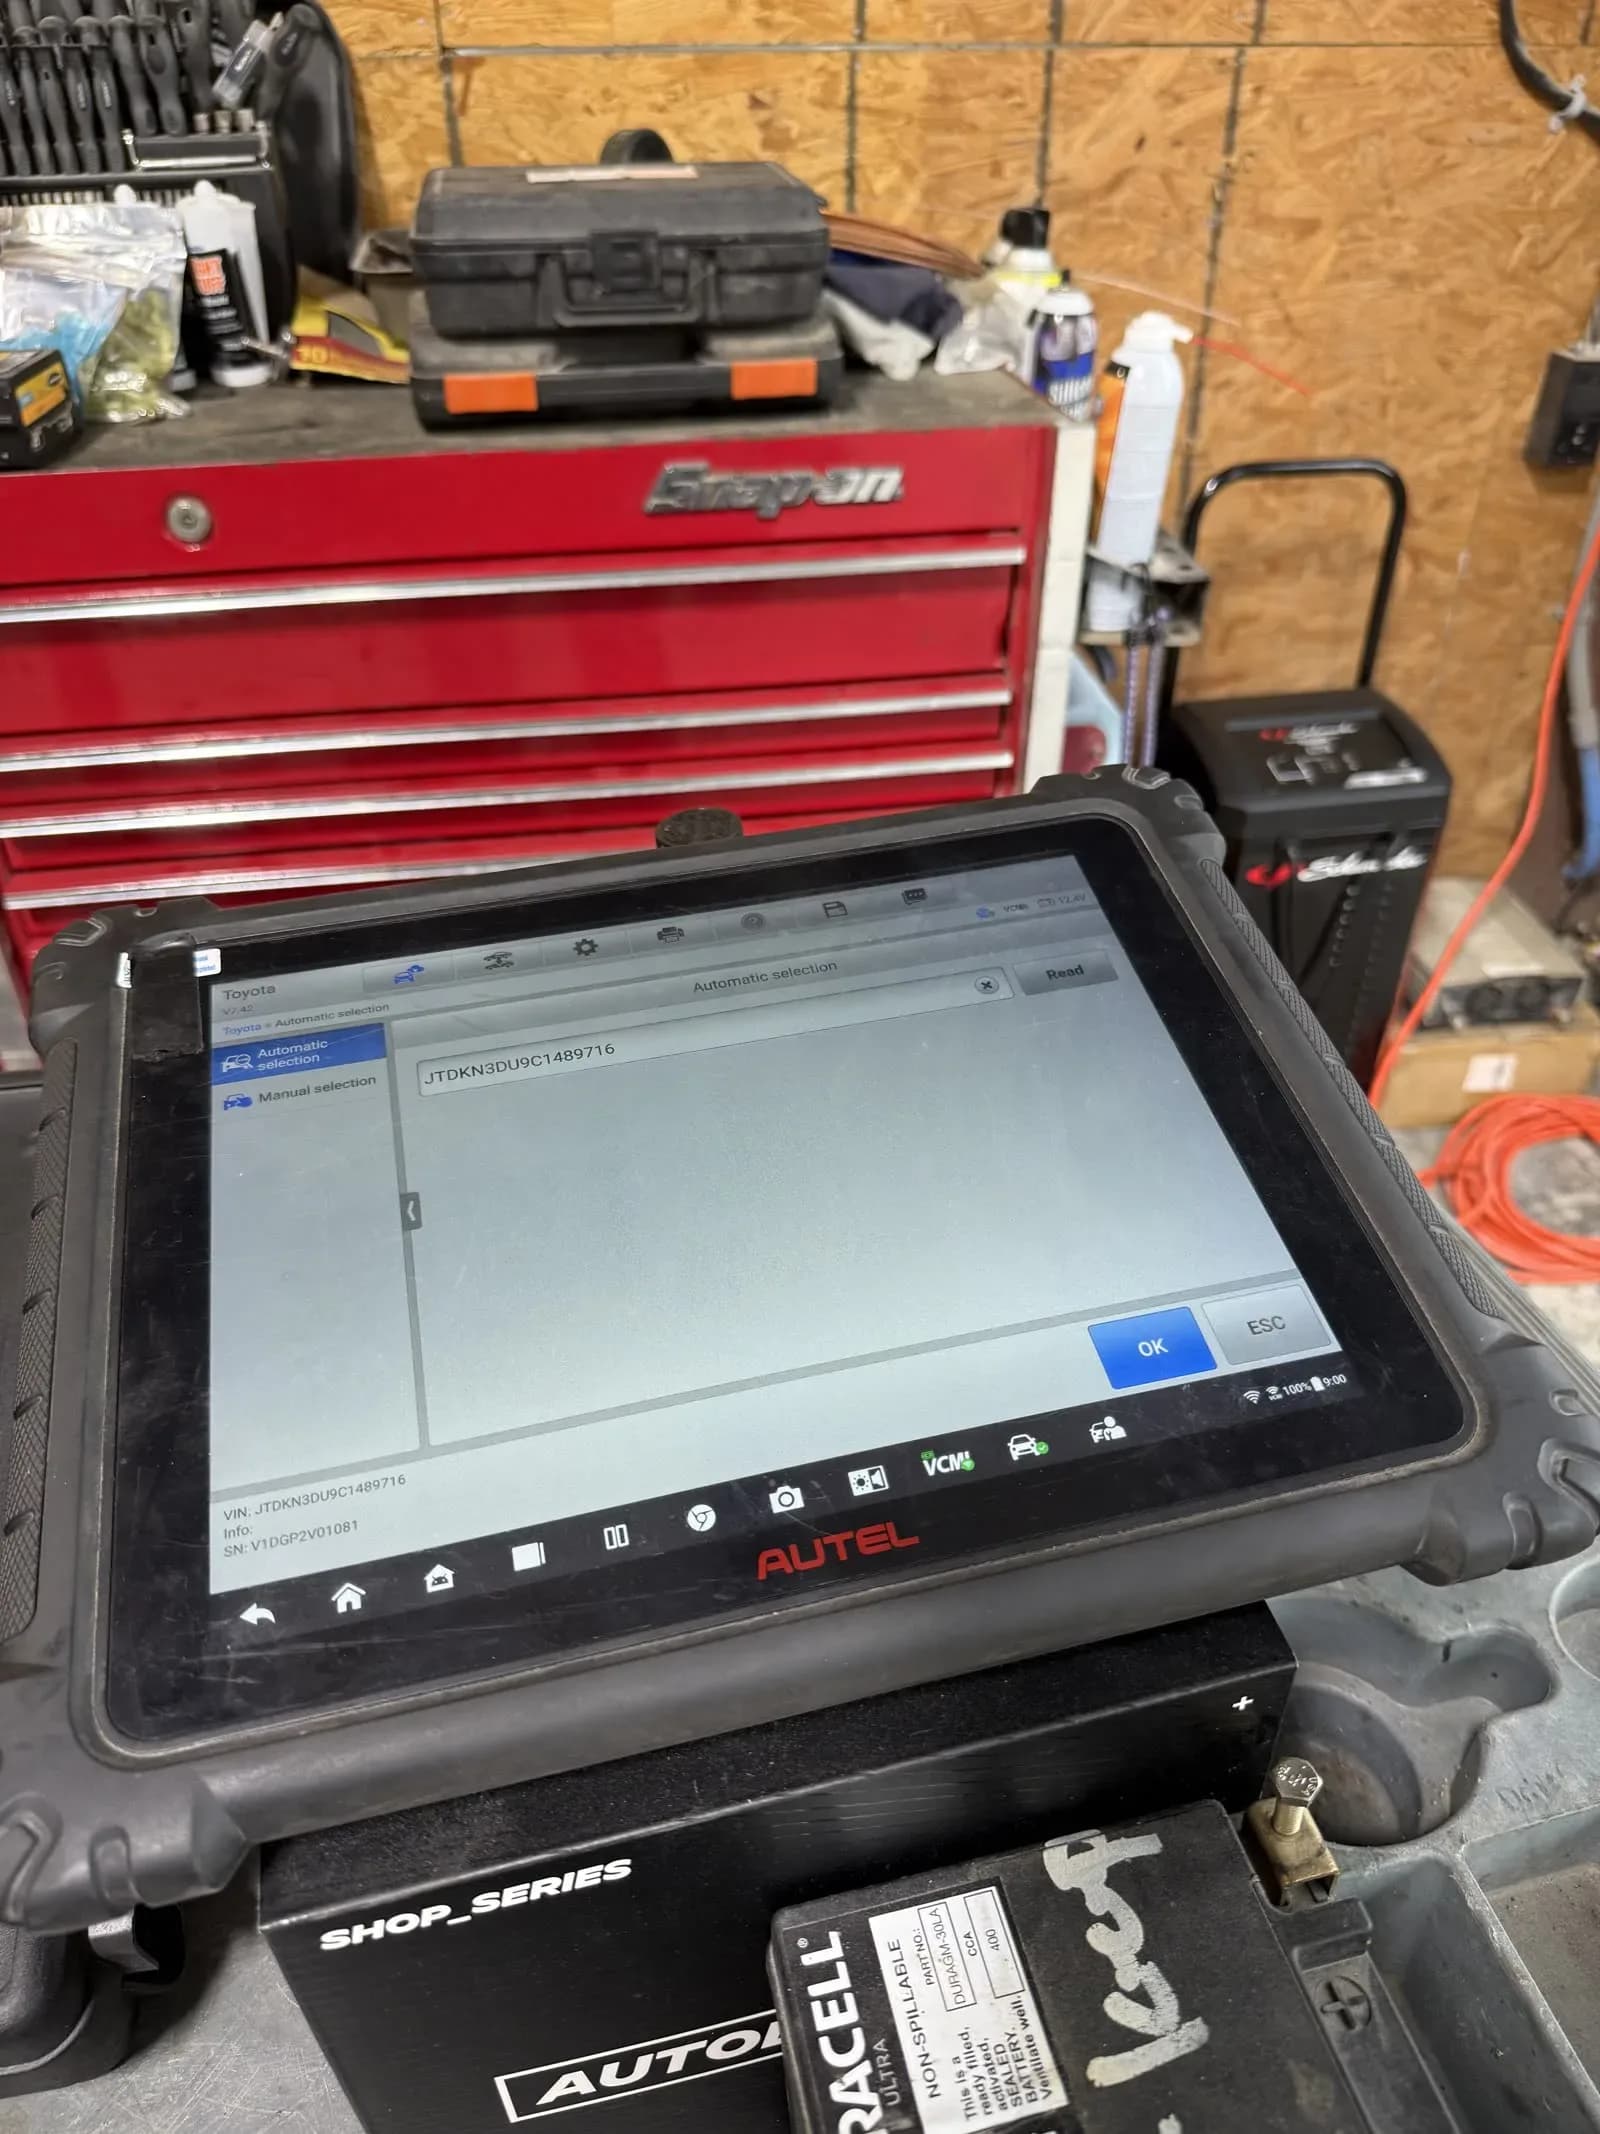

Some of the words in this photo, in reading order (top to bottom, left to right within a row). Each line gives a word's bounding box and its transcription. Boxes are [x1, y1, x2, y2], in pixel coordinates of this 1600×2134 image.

[692, 969, 769, 994] Automatic
[772, 960, 839, 981] selection
[1046, 964, 1085, 980] Read
[223, 984, 276, 1001] Toyota
[222, 1022, 262, 1036] Toyota
[275, 1010, 336, 1027] Automatic
[337, 1002, 390, 1019] selection
[257, 1039, 329, 1058] Automatic
[258, 1053, 320, 1071] selection
[423, 1042, 616, 1086] JTDKN3DU9C1489716
[259, 1084, 311, 1103] Manual
[314, 1075, 377, 1094] selection
[1246, 1314, 1287, 1337] ESC
[1137, 1337, 1169, 1359] OK
[1282, 1381, 1313, 1396] 100%
[1322, 1373, 1347, 1387] 9:00
[223, 1505, 252, 1521] VIN:
[255, 1474, 407, 1515] JTDKN3DU9C1489716
[223, 1524, 254, 1540] Info:
[223, 1543, 248, 1558] SN:
[251, 1519, 359, 1552] V1DGP2V01081
[757, 1520, 919, 1580] AUTEL
[320, 1858, 633, 1950] SHOP_SERIES
[929, 1907, 967, 2005] DURAGM-30LA
[963, 1931, 978, 1957] CCA
[986, 1928, 1000, 1951] 400
[919, 1955, 936, 1986] PART
[887, 1938, 942, 2099] NON-SPILLABLE
[1011, 1995, 1031, 2030] well.
[952, 2056, 962, 2065] a
[957, 2026, 979, 2070] filled,
[1004, 2027, 1038, 2103] BATTERY.
[872, 2038, 900, 2106] ULTRA
[955, 2070, 966, 2084] is
[977, 2037, 1008, 2110] activated,
[993, 2043, 1023, 2108] SEALED
[1025, 2034, 1053, 2100] Ventilate
[960, 2090, 977, 2121] This
[973, 2074, 993, 2116] ready
